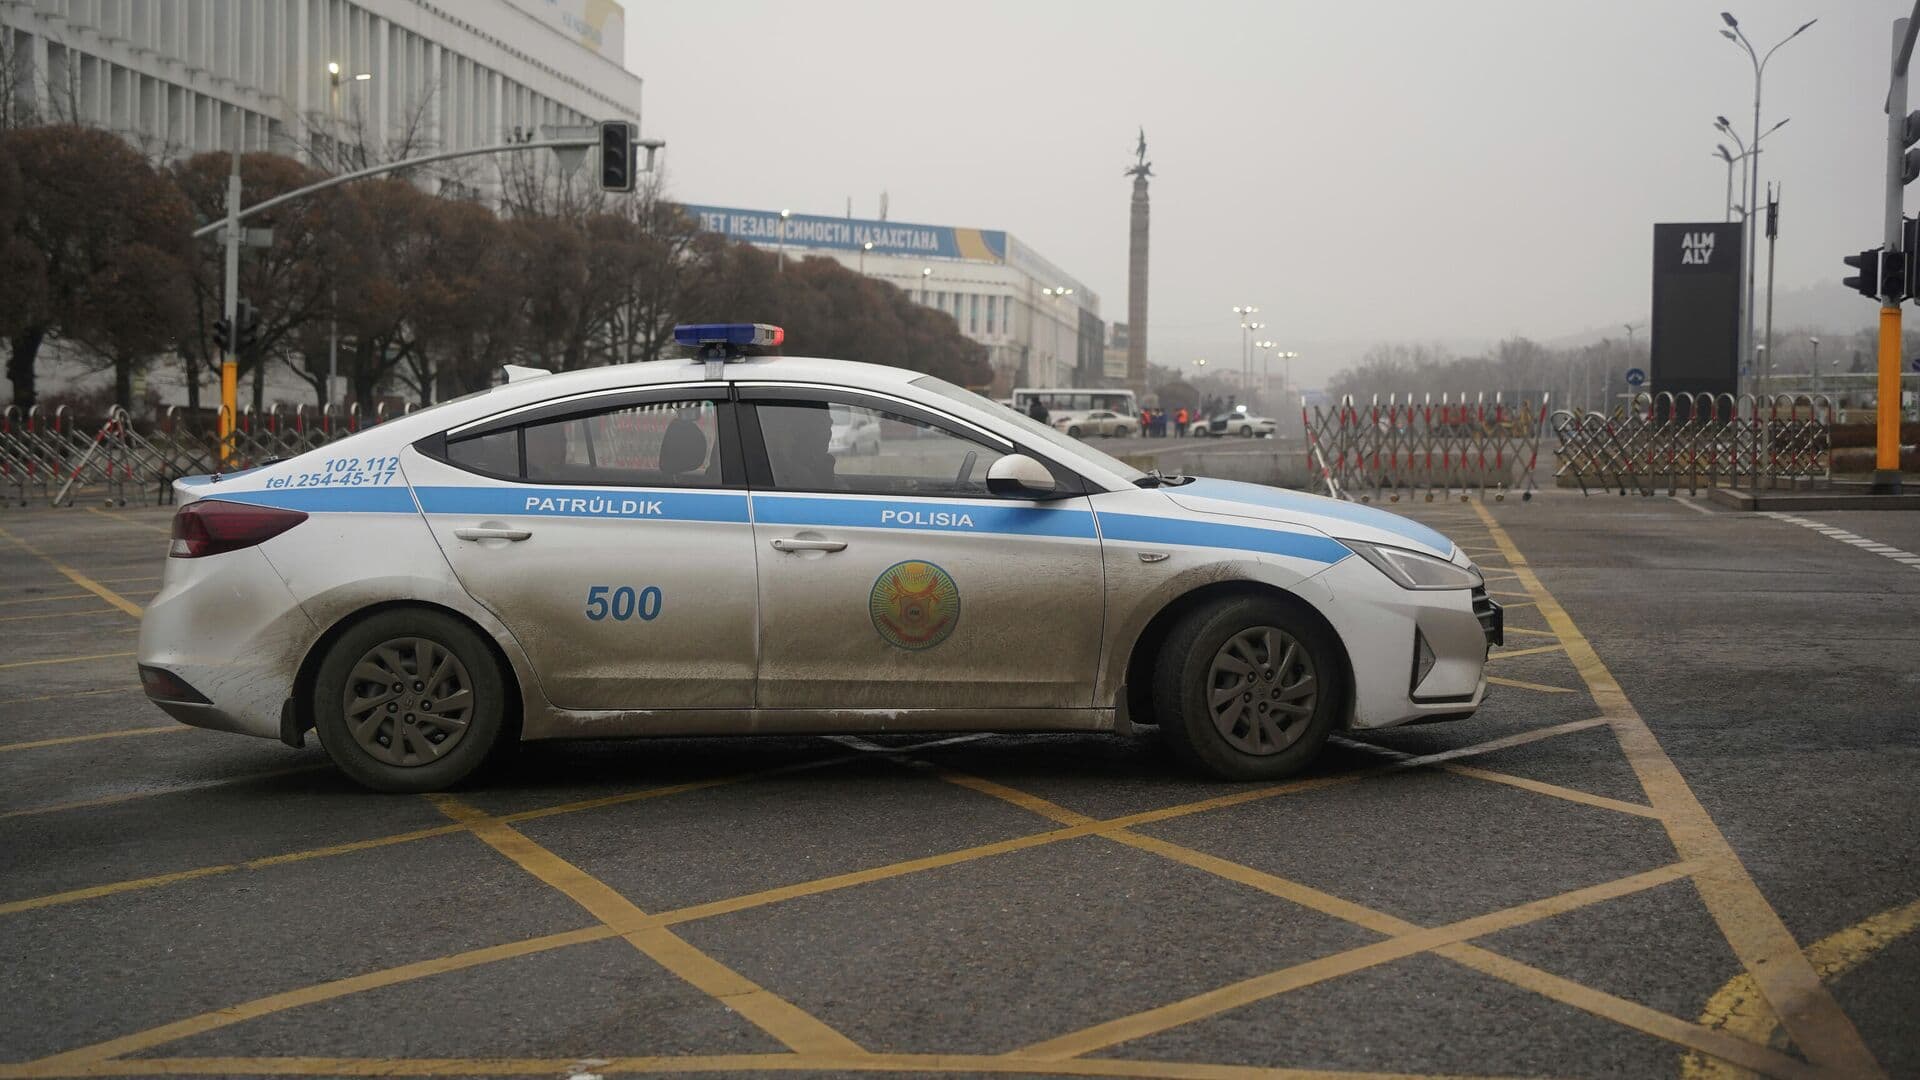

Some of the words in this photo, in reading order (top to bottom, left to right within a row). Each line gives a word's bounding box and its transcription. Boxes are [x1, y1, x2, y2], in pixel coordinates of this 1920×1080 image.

[854, 225, 939, 250] КАЗАХСТАНА
[1681, 232, 1714, 248] ALM
[1681, 249, 1713, 264] ALY
[326, 457, 400, 472] 102.112
[525, 496, 663, 515] PATRÚLDIK
[881, 510, 974, 527] POLISIA
[585, 586, 662, 621] 500
